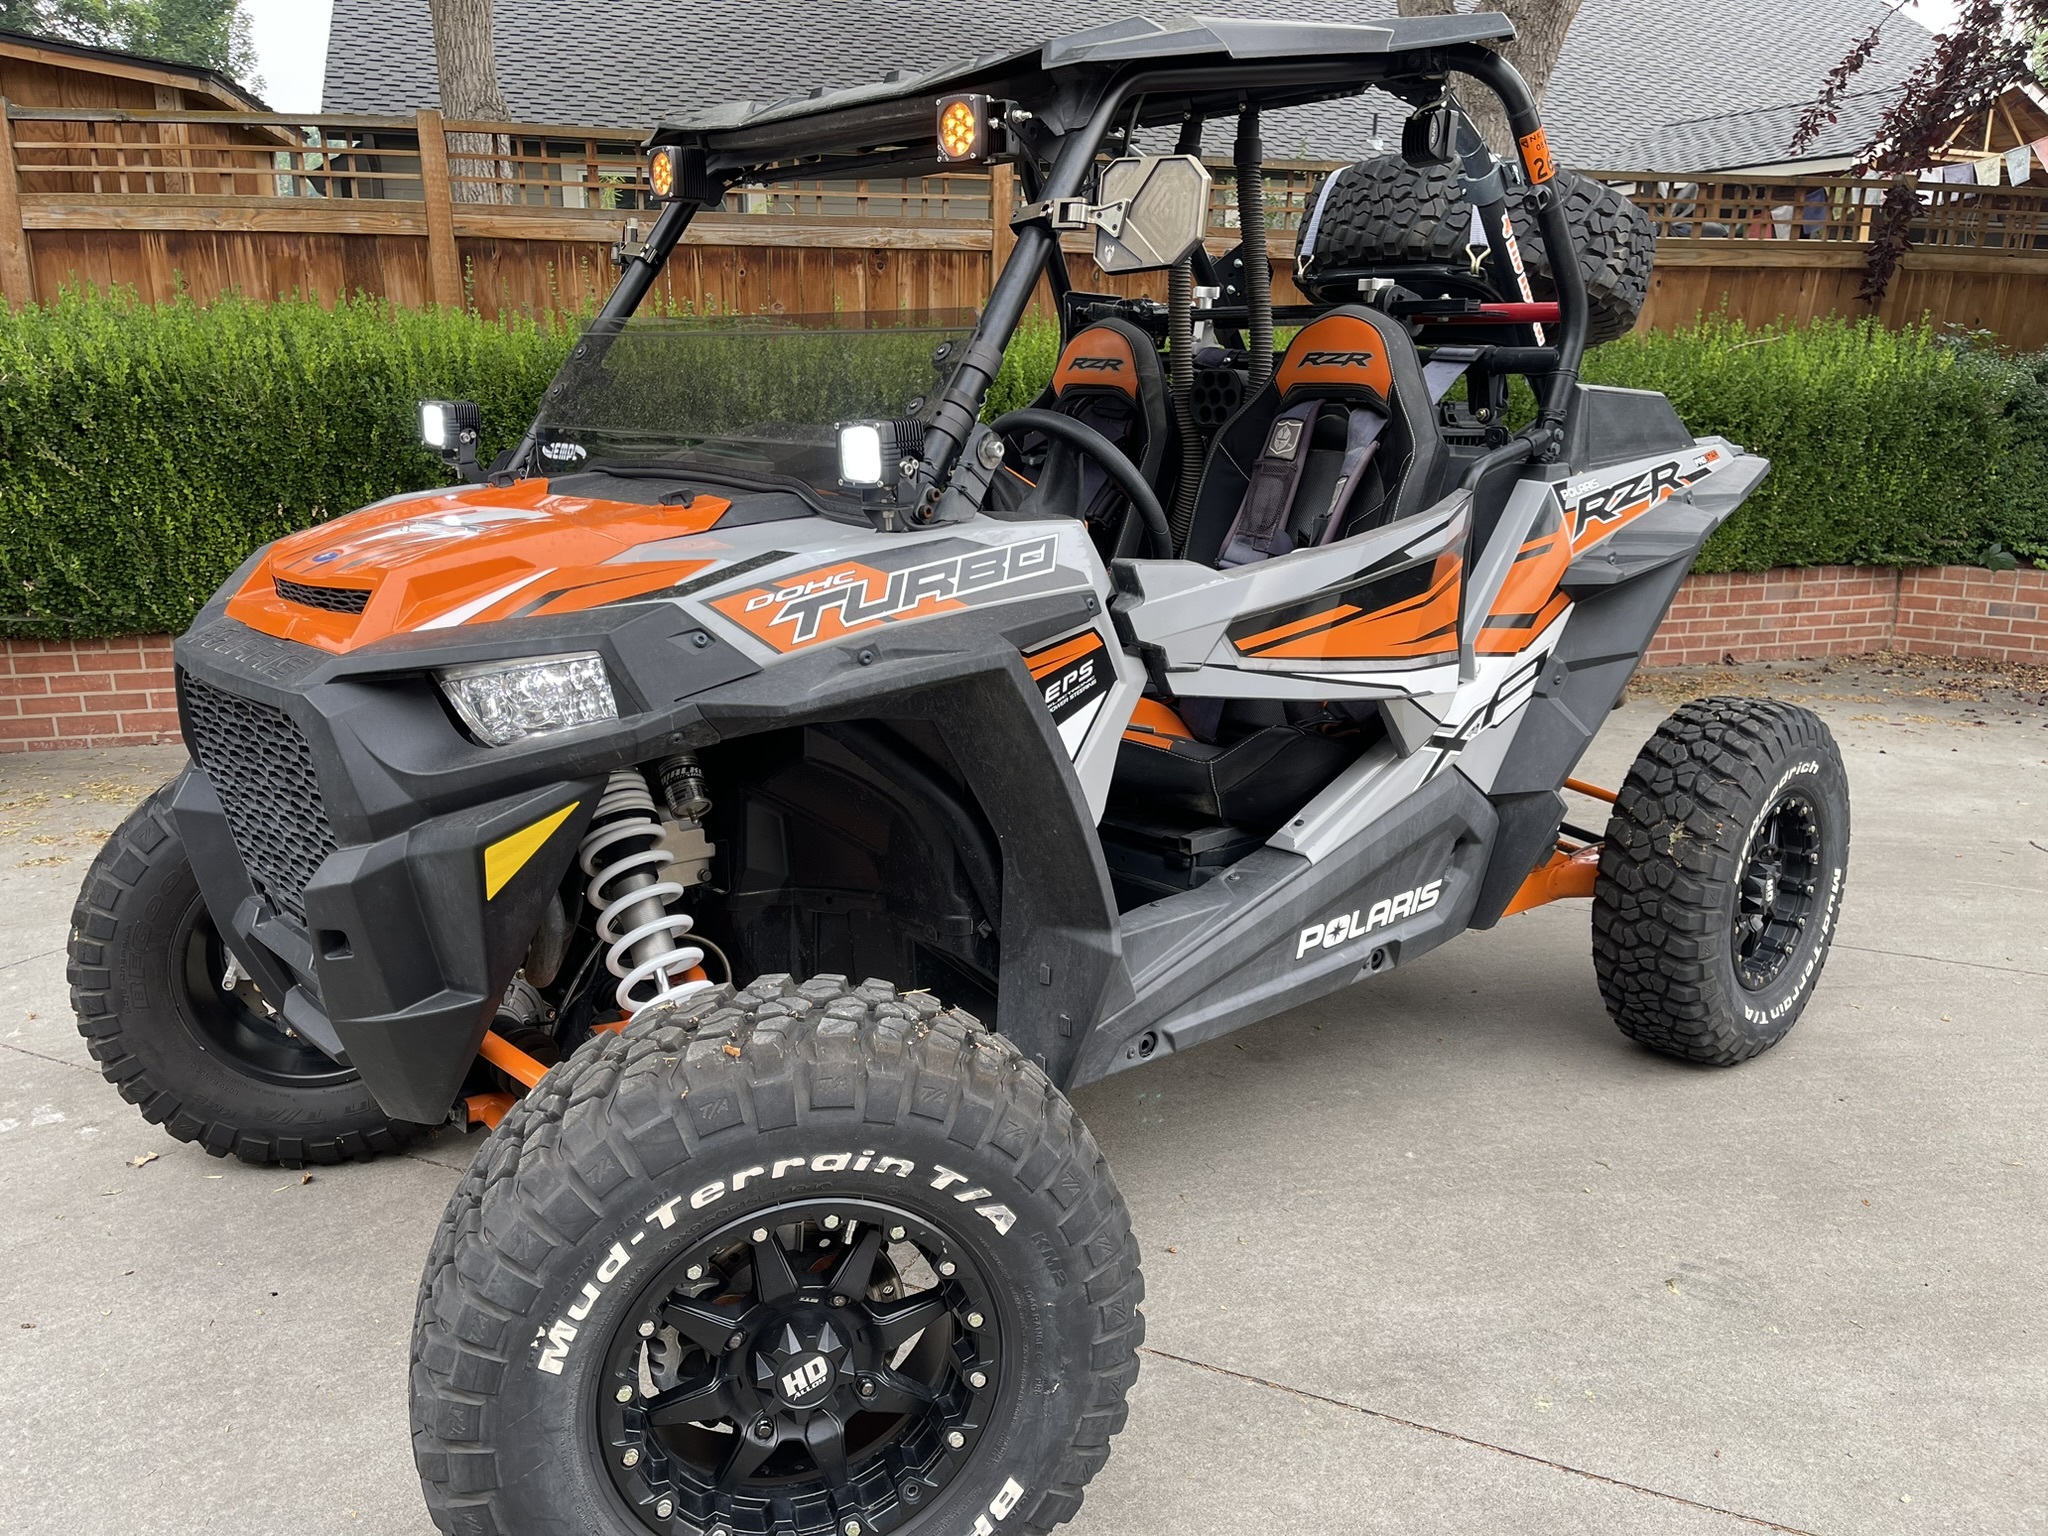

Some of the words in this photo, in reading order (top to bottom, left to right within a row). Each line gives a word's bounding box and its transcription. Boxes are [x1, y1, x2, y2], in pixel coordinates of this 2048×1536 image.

[1067, 357, 1124, 372] RZR
[1297, 351, 1373, 369] RZR
[1560, 478, 1601, 500] POLARIS
[1571, 459, 1687, 544] RZR
[745, 570, 856, 612] DOHC
[768, 543, 1060, 645] TURBO
[1045, 658, 1095, 703] EPS
[1295, 878, 1443, 960] POLARIS
[1770, 868, 1842, 1020] Mud-Terrain
[1744, 1004, 1769, 1025] T/A
[599, 1190, 670, 1249] Sidewall
[537, 1150, 915, 1376] Mud-Terrain
[930, 1164, 1018, 1237] T/A
[1031, 1232, 1068, 1288] KM2
[1023, 1285, 1038, 1313] LOAD
[1032, 1313, 1044, 1348] RANGE
[782, 1355, 828, 1397] HD
[1034, 1351, 1044, 1361] C
[793, 1376, 827, 1401] ALLOY
